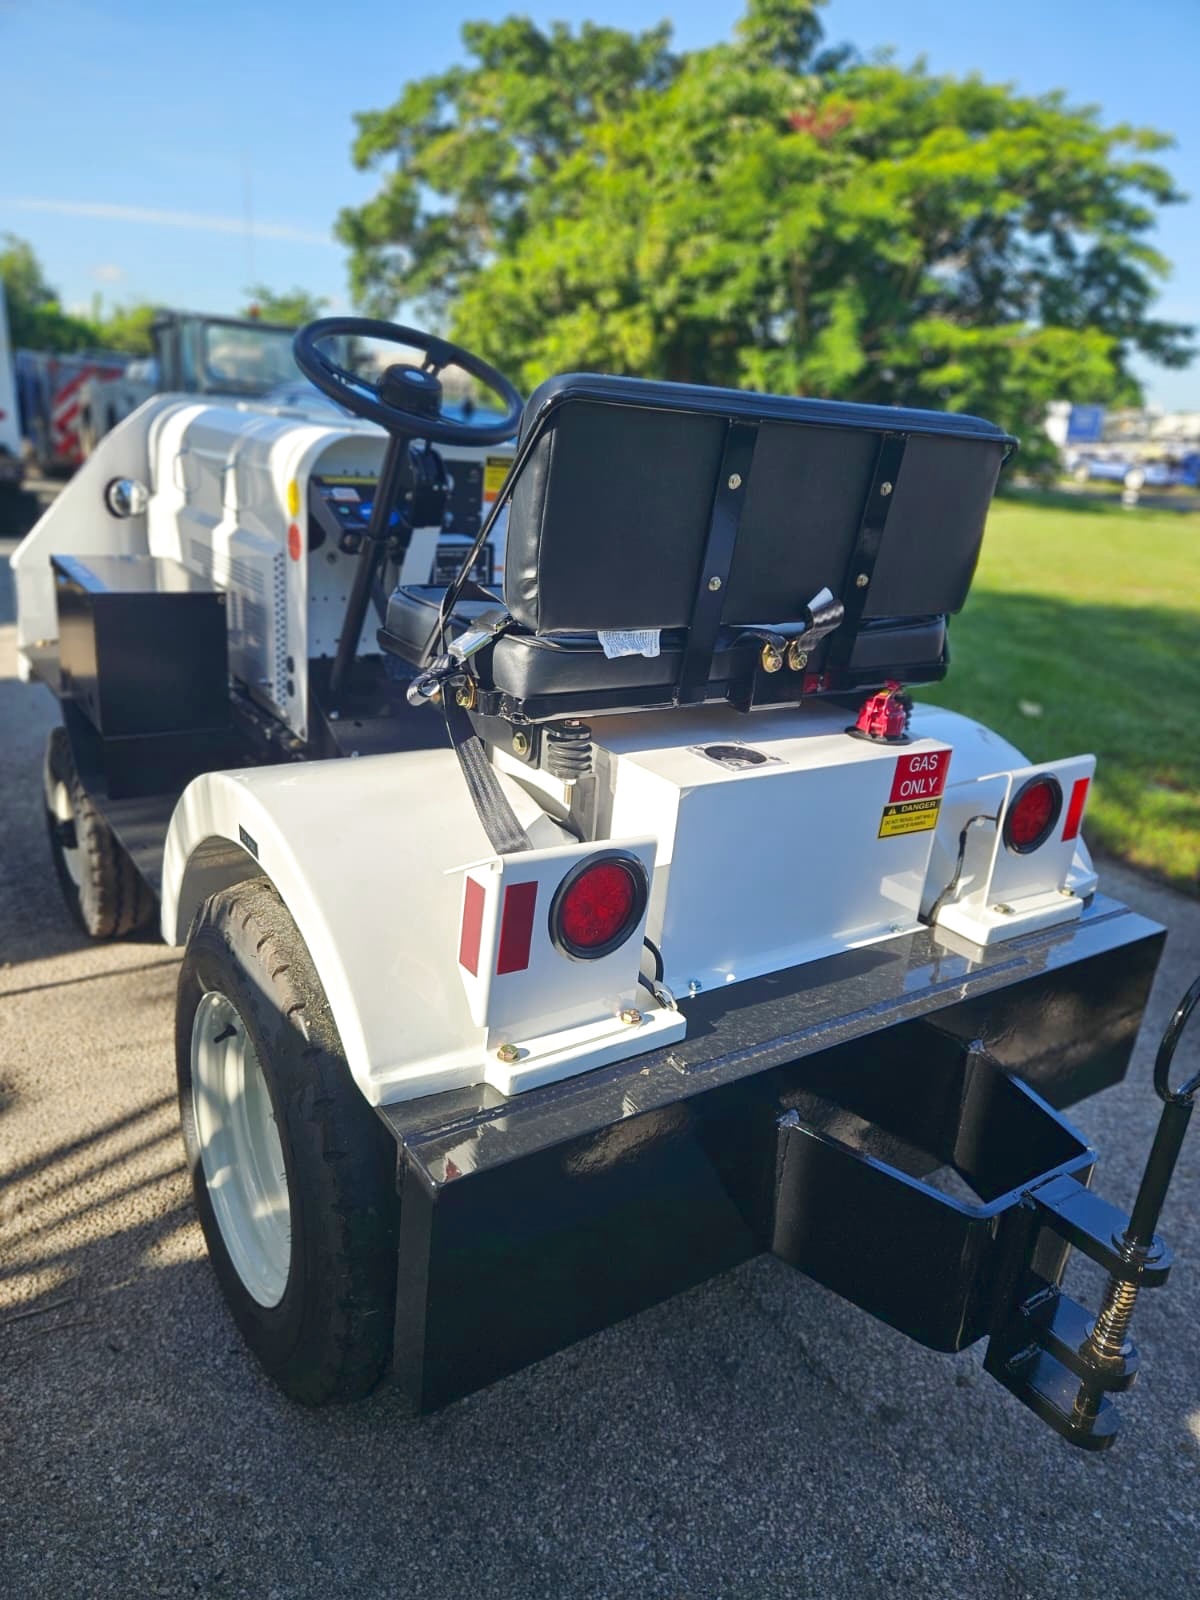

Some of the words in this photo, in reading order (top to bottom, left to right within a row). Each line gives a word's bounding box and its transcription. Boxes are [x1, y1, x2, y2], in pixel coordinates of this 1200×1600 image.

[909, 754, 939, 773] GAS
[900, 777, 938, 797] ONLY
[901, 801, 937, 813] DANGER
